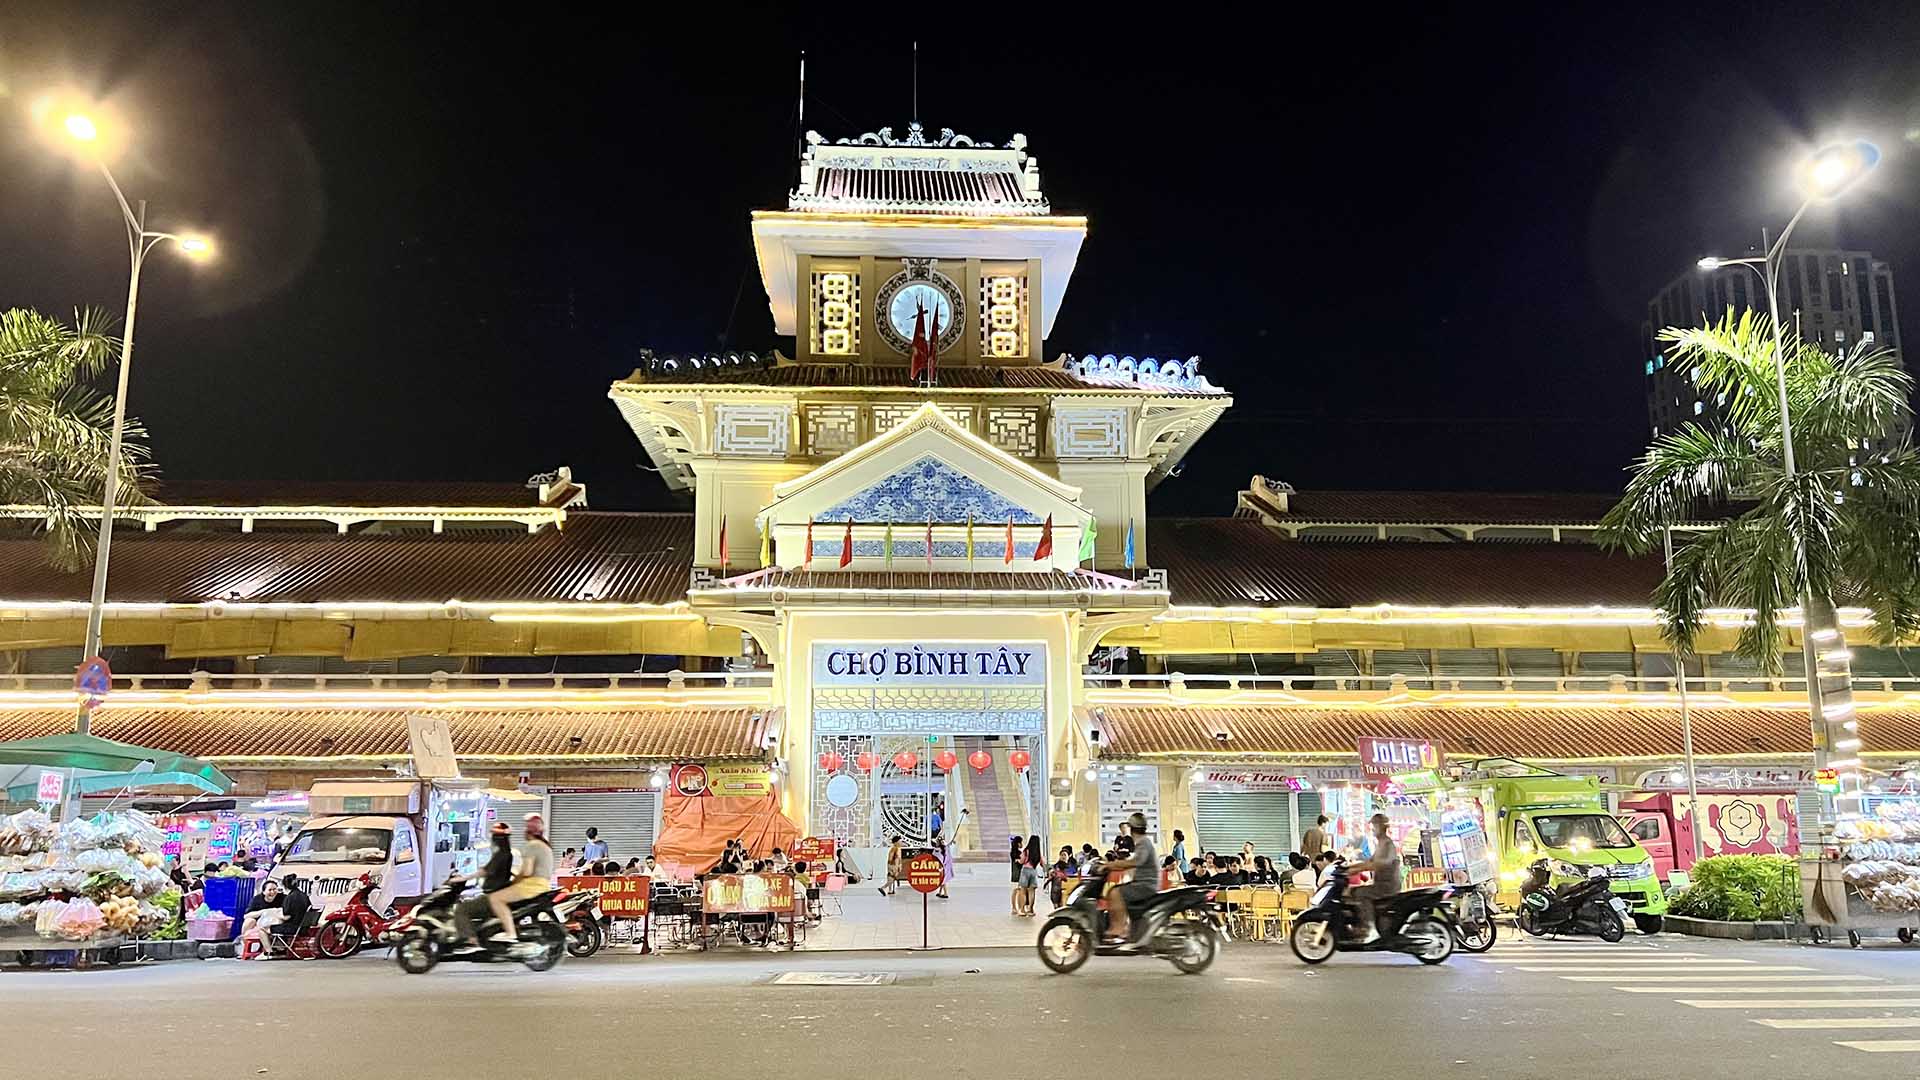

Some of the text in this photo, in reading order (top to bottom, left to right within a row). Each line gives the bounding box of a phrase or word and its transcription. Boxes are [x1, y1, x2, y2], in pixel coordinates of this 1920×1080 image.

[827, 646, 1032, 682] CHỢ BÌNH TÂY
[911, 857, 940, 870] CẤM
[623, 880, 636, 892] XE
[602, 896, 645, 911] MUA BÁN
[771, 894, 792, 907] BÁN
